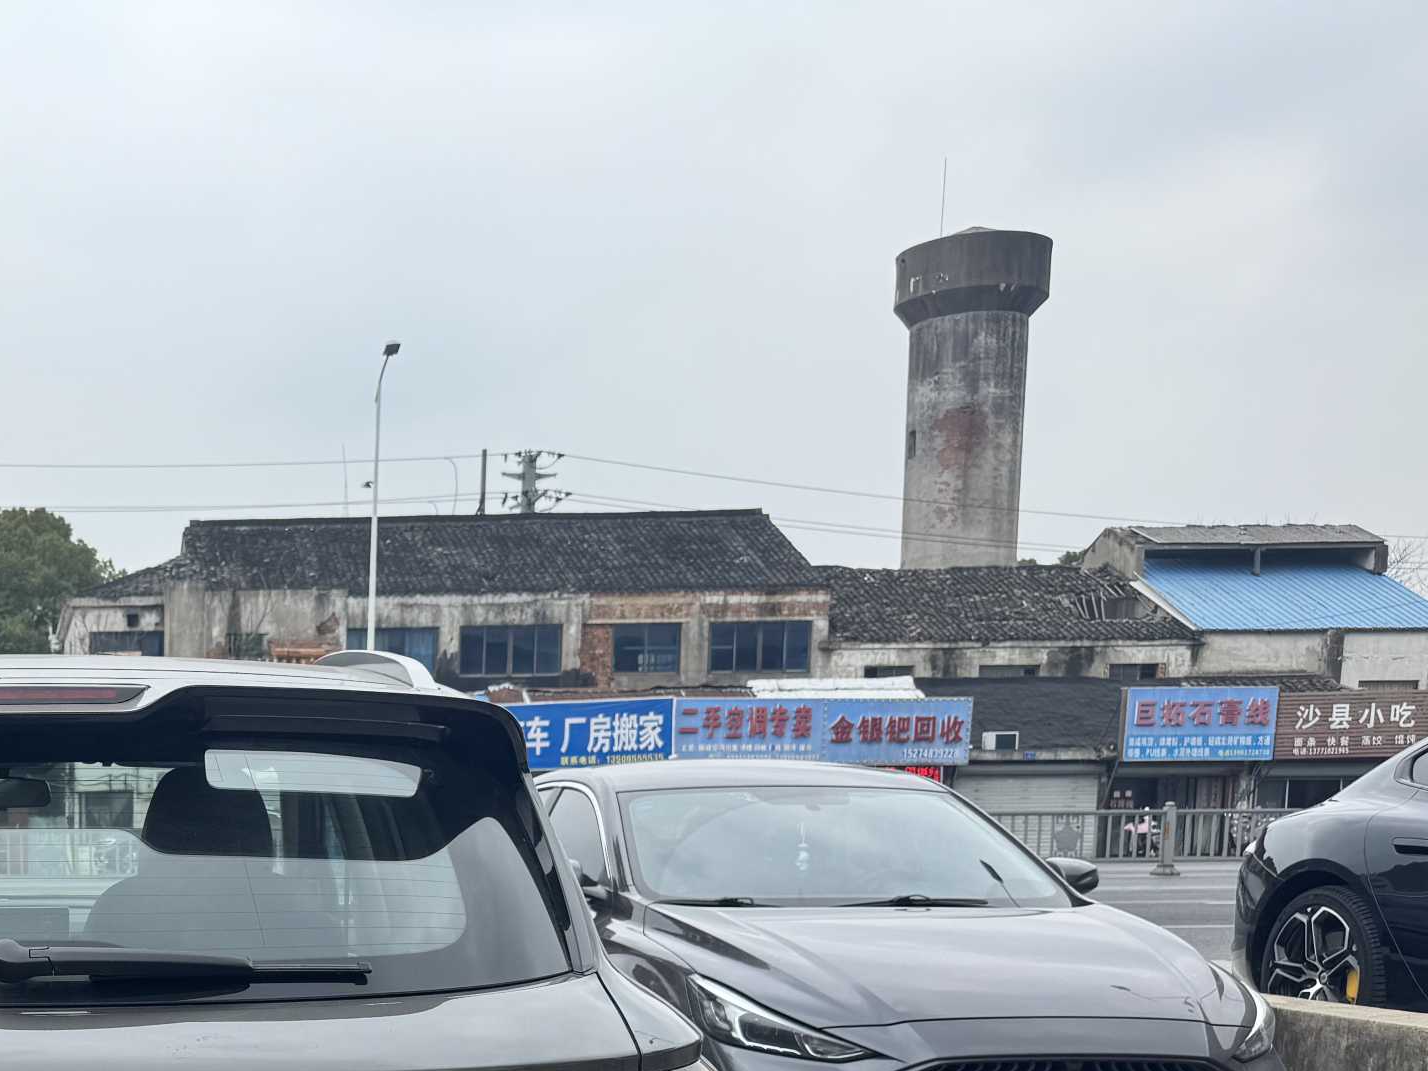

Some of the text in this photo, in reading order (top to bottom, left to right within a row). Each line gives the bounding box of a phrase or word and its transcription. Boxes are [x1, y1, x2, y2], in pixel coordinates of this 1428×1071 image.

[828, 714, 965, 744] 金银钯回收
[1294, 702, 1416, 730] 沙县小吃
[560, 711, 665, 753] 厂房搬家
